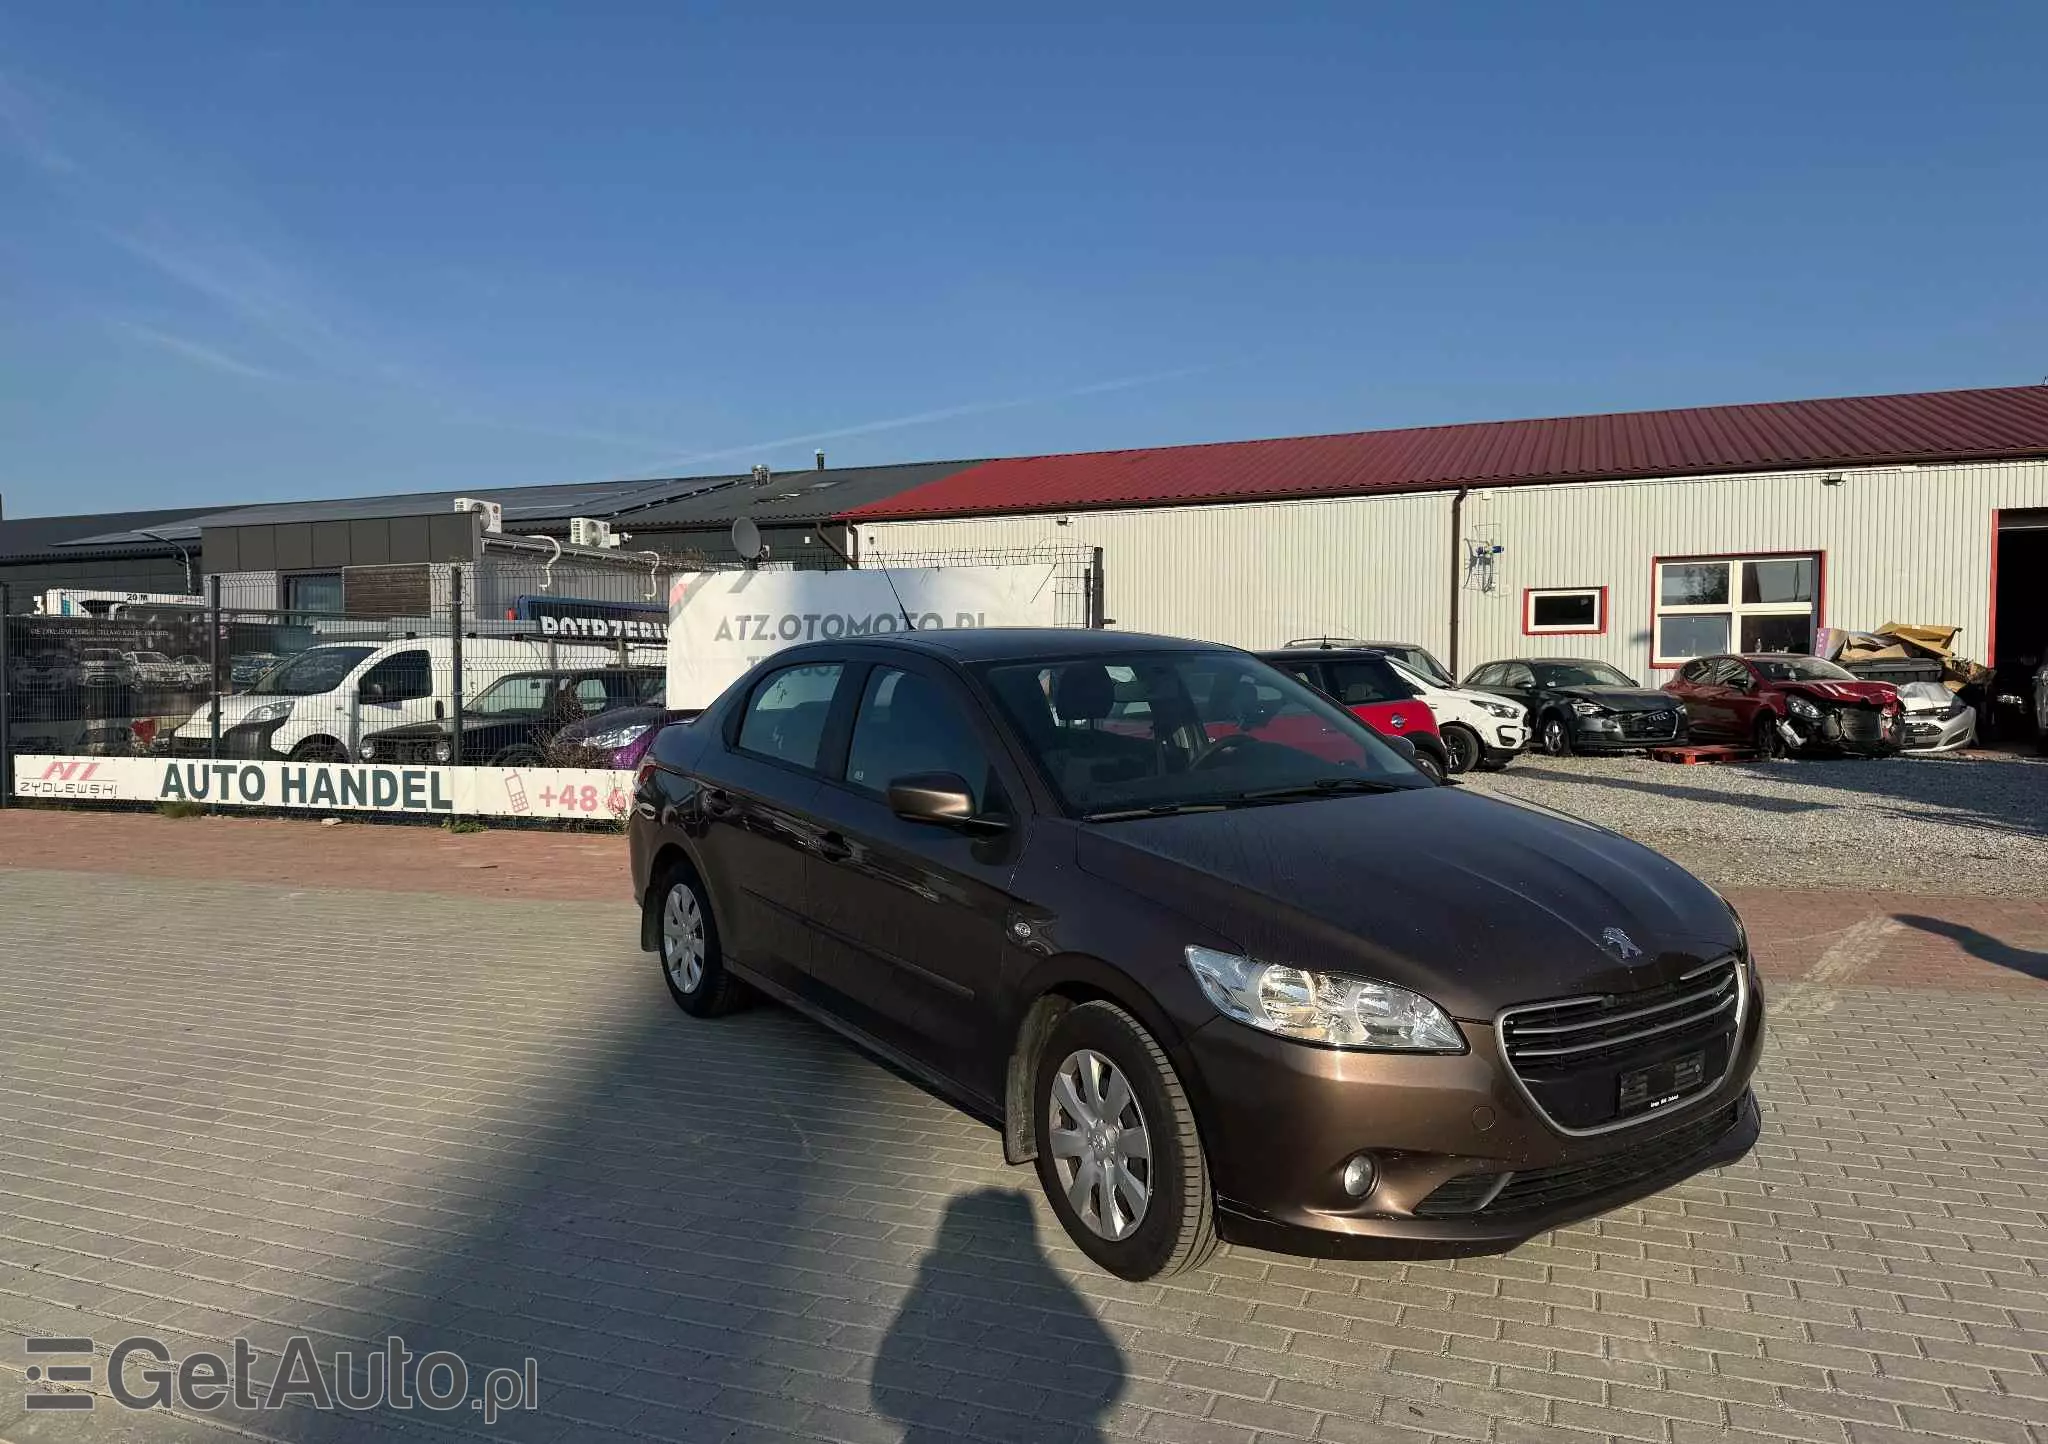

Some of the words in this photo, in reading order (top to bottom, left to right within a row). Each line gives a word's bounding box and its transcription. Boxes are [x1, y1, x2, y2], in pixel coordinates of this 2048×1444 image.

[126, 593, 138, 601] 20
[714, 612, 985, 641] ATZ.OTOMOTOP
[160, 763, 265, 801] AUTO
[281, 767, 453, 809] HANDEL
[538, 784, 598, 811] +48
